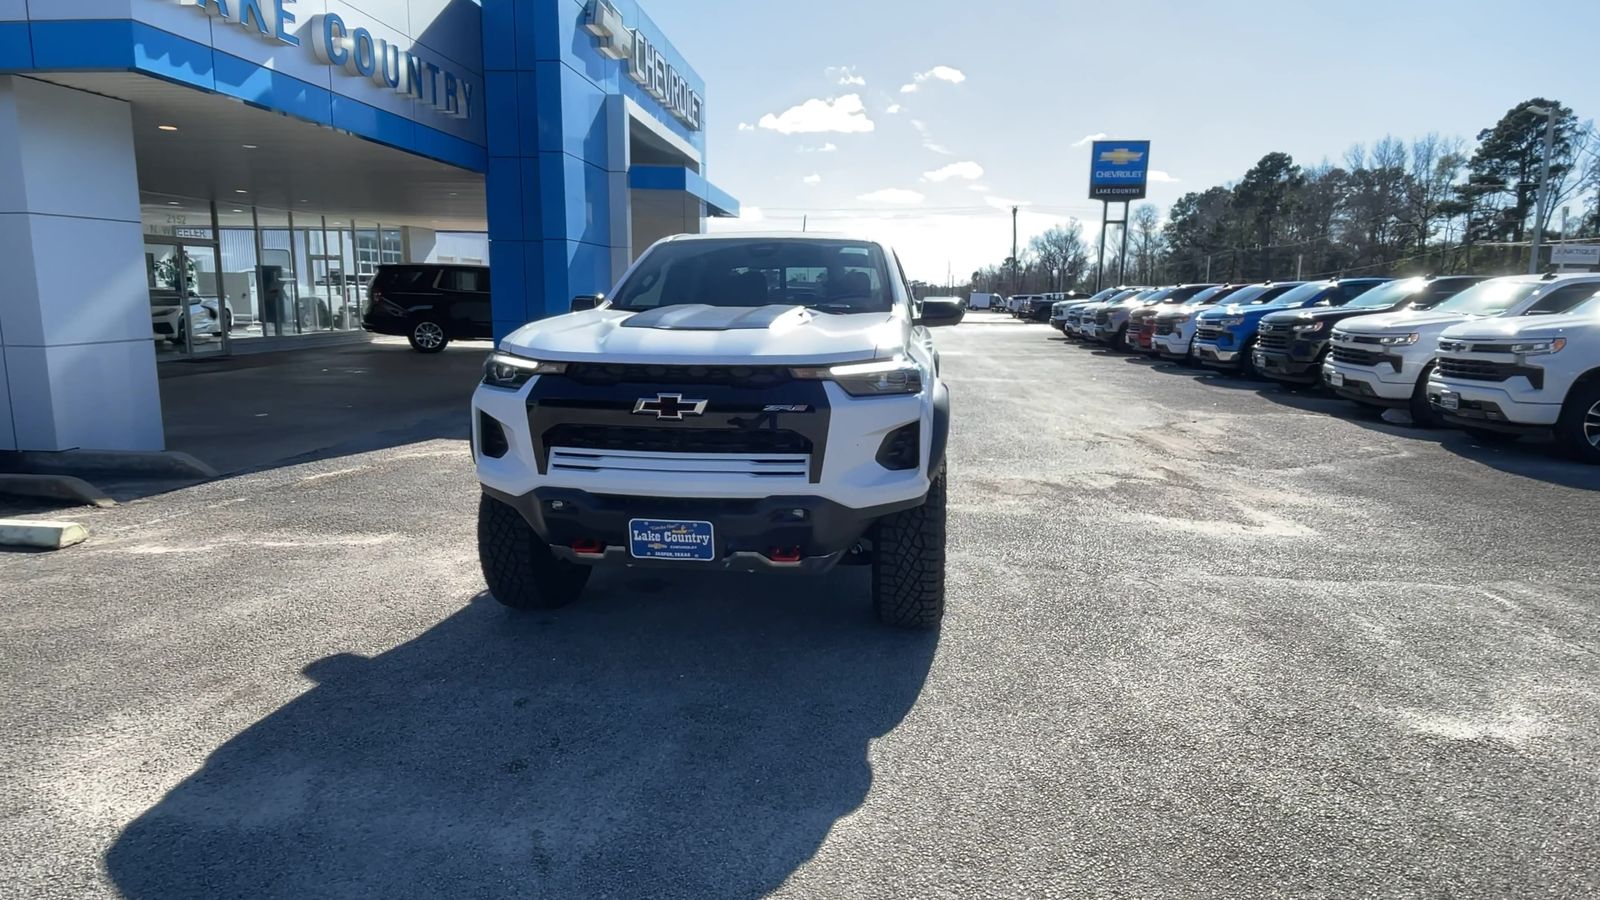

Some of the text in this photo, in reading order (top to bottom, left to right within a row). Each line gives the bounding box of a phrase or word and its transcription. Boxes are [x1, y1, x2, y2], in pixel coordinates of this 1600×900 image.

[197, 0, 473, 119] KE COUNTRY
[634, 29, 702, 129] CHEVROLET
[1096, 170, 1143, 178] CHEVROLET
[167, 214, 186, 225] 2152
[633, 530, 709, 545] Lake Country
